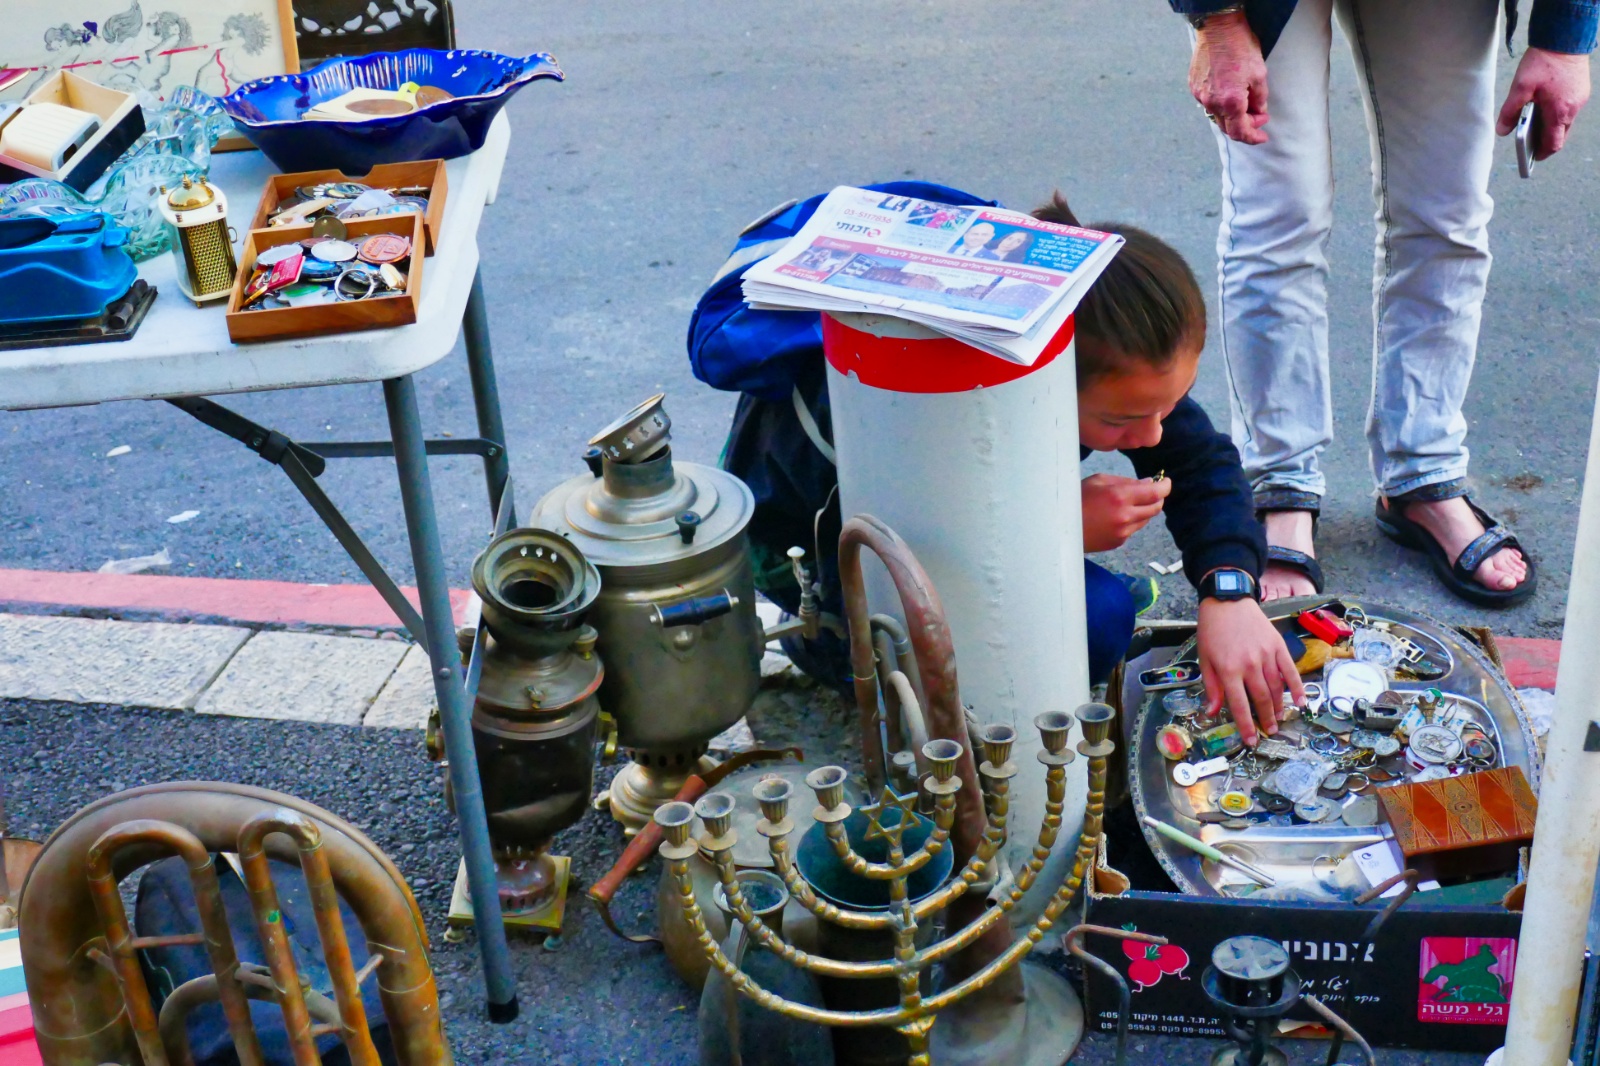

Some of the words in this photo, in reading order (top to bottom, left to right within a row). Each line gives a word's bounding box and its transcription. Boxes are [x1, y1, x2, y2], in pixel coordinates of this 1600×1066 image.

[836, 221, 871, 235] זכותי
[875, 246, 908, 258] ליברפול
[908, 252, 920, 260] על
[921, 255, 960, 267] מסתערים
[961, 261, 1004, 274] הישראלים
[1003, 268, 1050, 283] המשקיעים
[1421, 1003, 1470, 1015] משה
[1477, 1002, 1503, 1016] גלי
[1132, 1013, 1159, 1022] מיקוד
[1161, 1014, 1185, 1023] 1444
[1100, 1021, 1156, 1032] 09-95543
